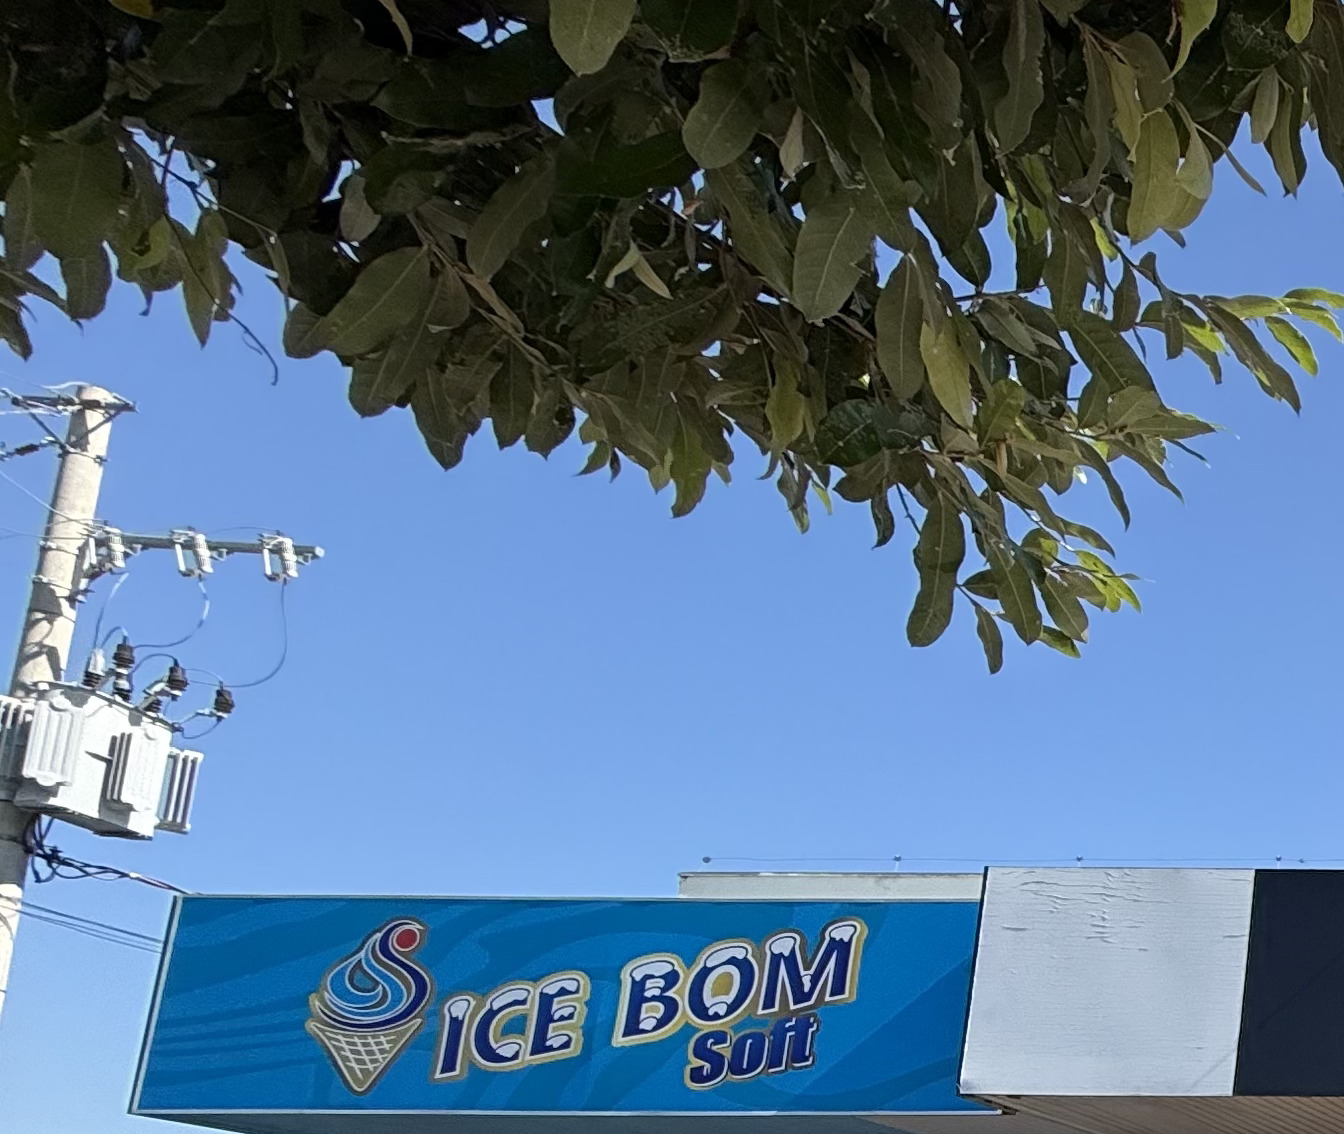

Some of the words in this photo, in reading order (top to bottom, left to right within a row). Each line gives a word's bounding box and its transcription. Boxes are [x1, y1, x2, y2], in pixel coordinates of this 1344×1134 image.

[433, 972, 590, 1082] ICE
[613, 917, 867, 1047] BOM
[685, 1016, 822, 1090] Soft
